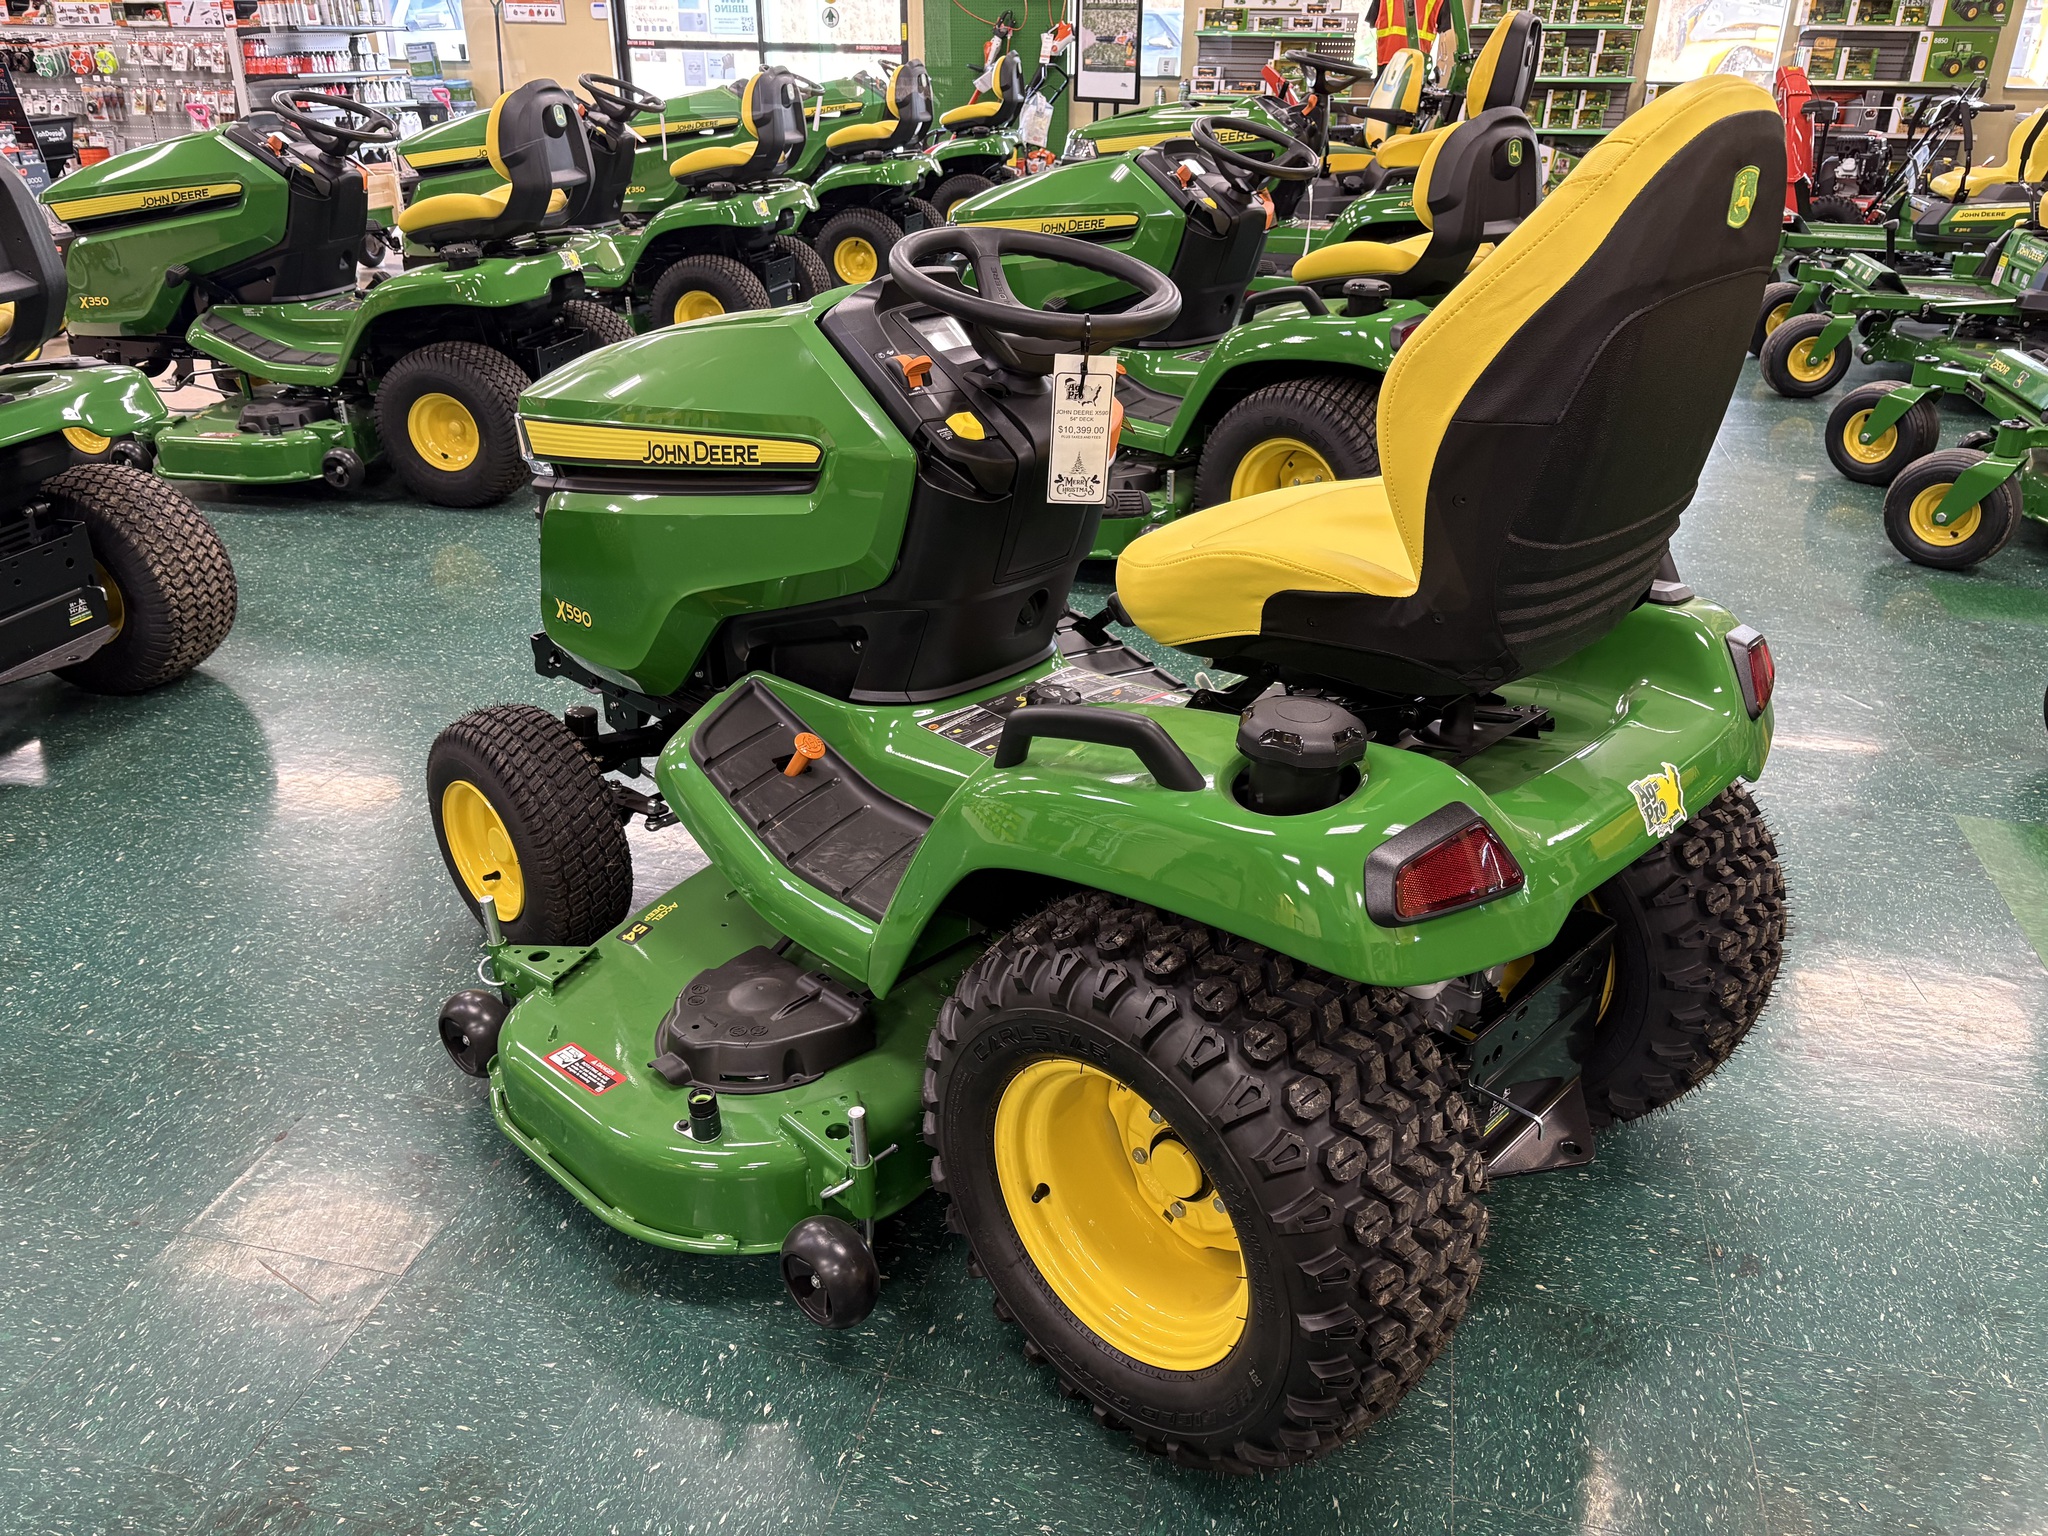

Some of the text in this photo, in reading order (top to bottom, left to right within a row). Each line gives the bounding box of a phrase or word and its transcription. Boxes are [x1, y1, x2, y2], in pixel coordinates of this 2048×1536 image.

[675, 124, 695, 132] JOHN
[141, 188, 209, 207] JOHN DEERE
[625, 185, 646, 195] X350
[1040, 218, 1106, 233] JOHN DEERE
[79, 296, 110, 309] X350
[1058, 426, 1104, 434] $10,399.00
[642, 440, 760, 464] JOHN DEERE
[553, 594, 594, 629] X590
[1643, 800, 1667, 832] Pro
[644, 904, 667, 922] DEEP
[651, 902, 679, 922] ACCEL
[622, 923, 649, 942] 54
[595, 1062, 616, 1075] DANGER
